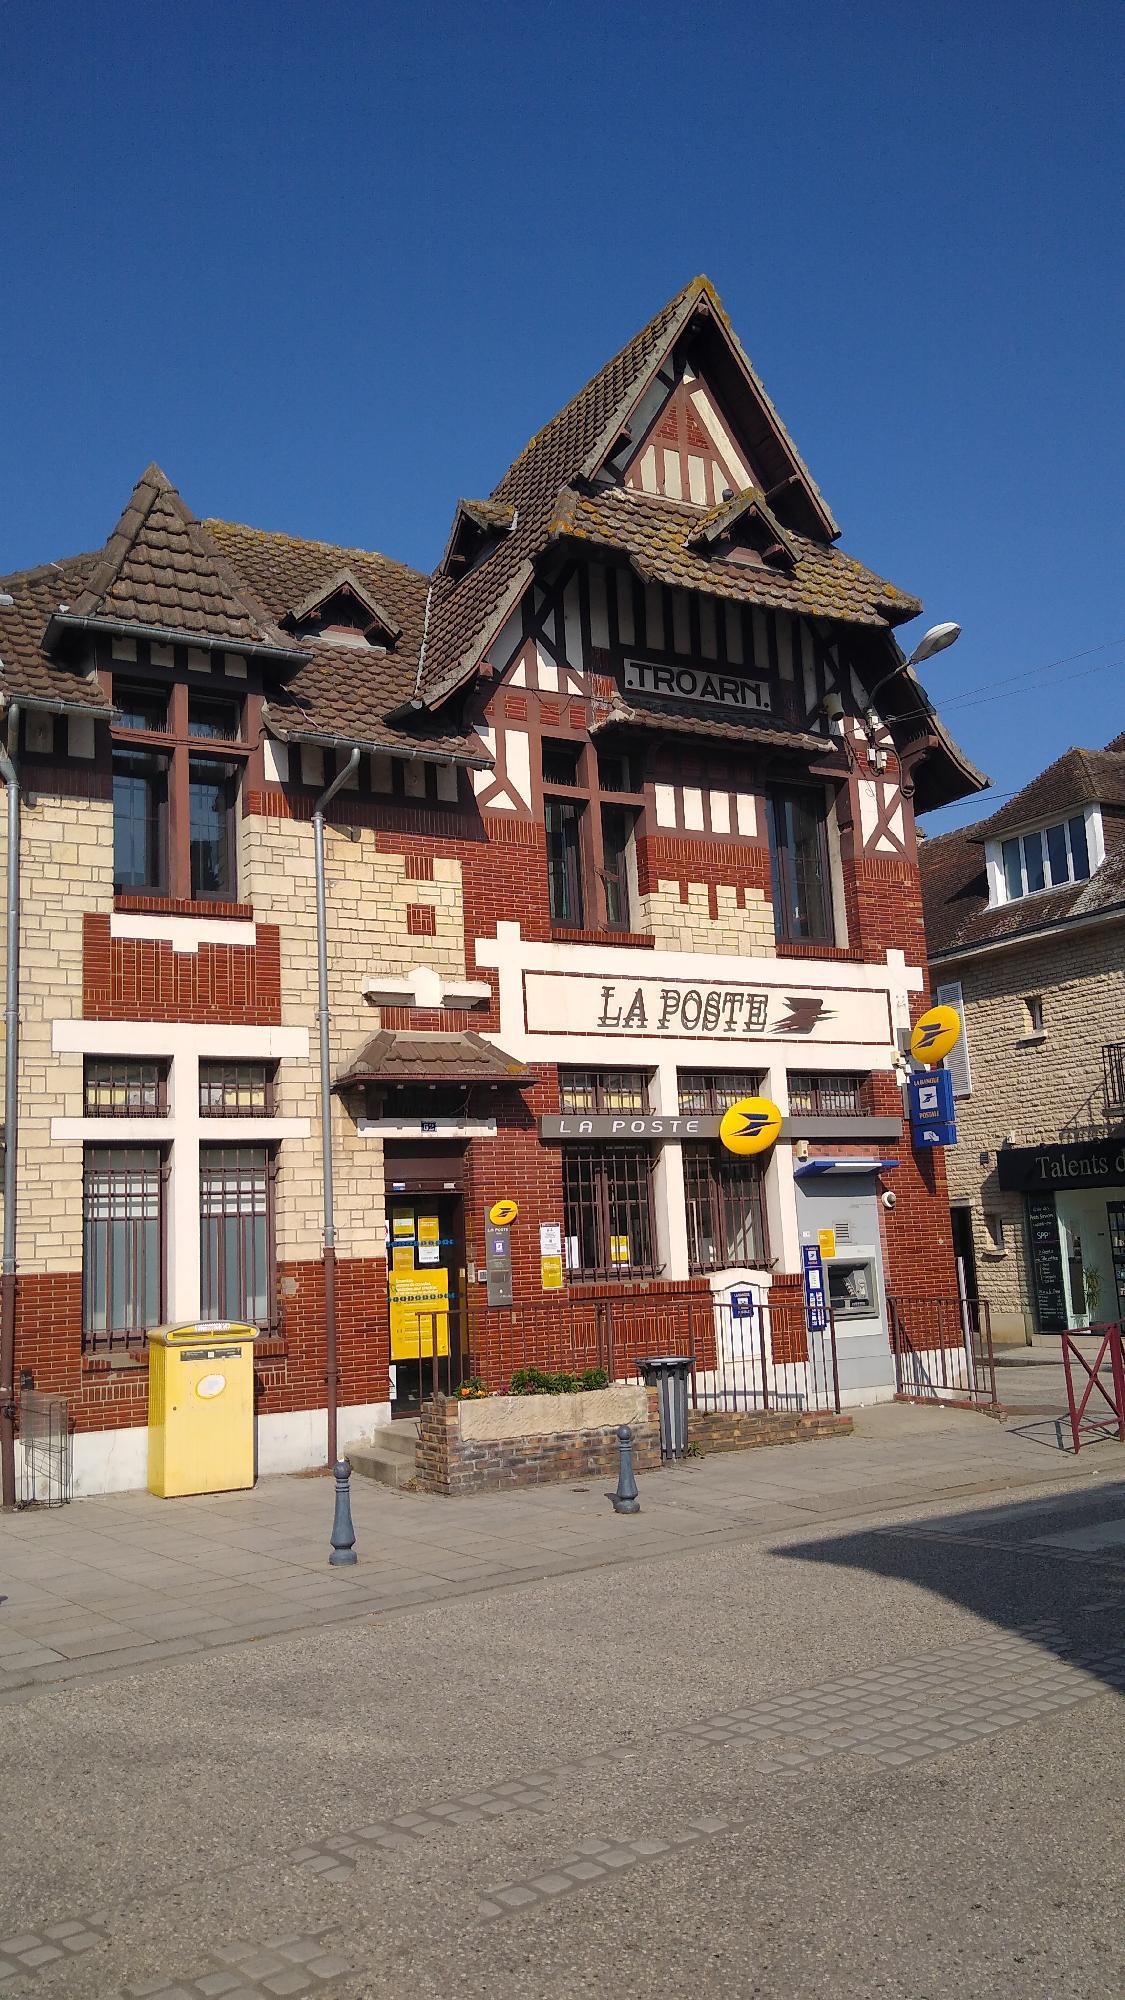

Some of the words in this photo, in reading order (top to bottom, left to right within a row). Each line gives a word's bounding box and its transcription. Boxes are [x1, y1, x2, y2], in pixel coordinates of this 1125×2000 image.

[597, 986, 648, 1029] LA
[656, 988, 769, 1033] POSTE
[559, 1120, 593, 1133] LA
[611, 1120, 700, 1133] POSTE
[1035, 1153, 1109, 1179] Talents
